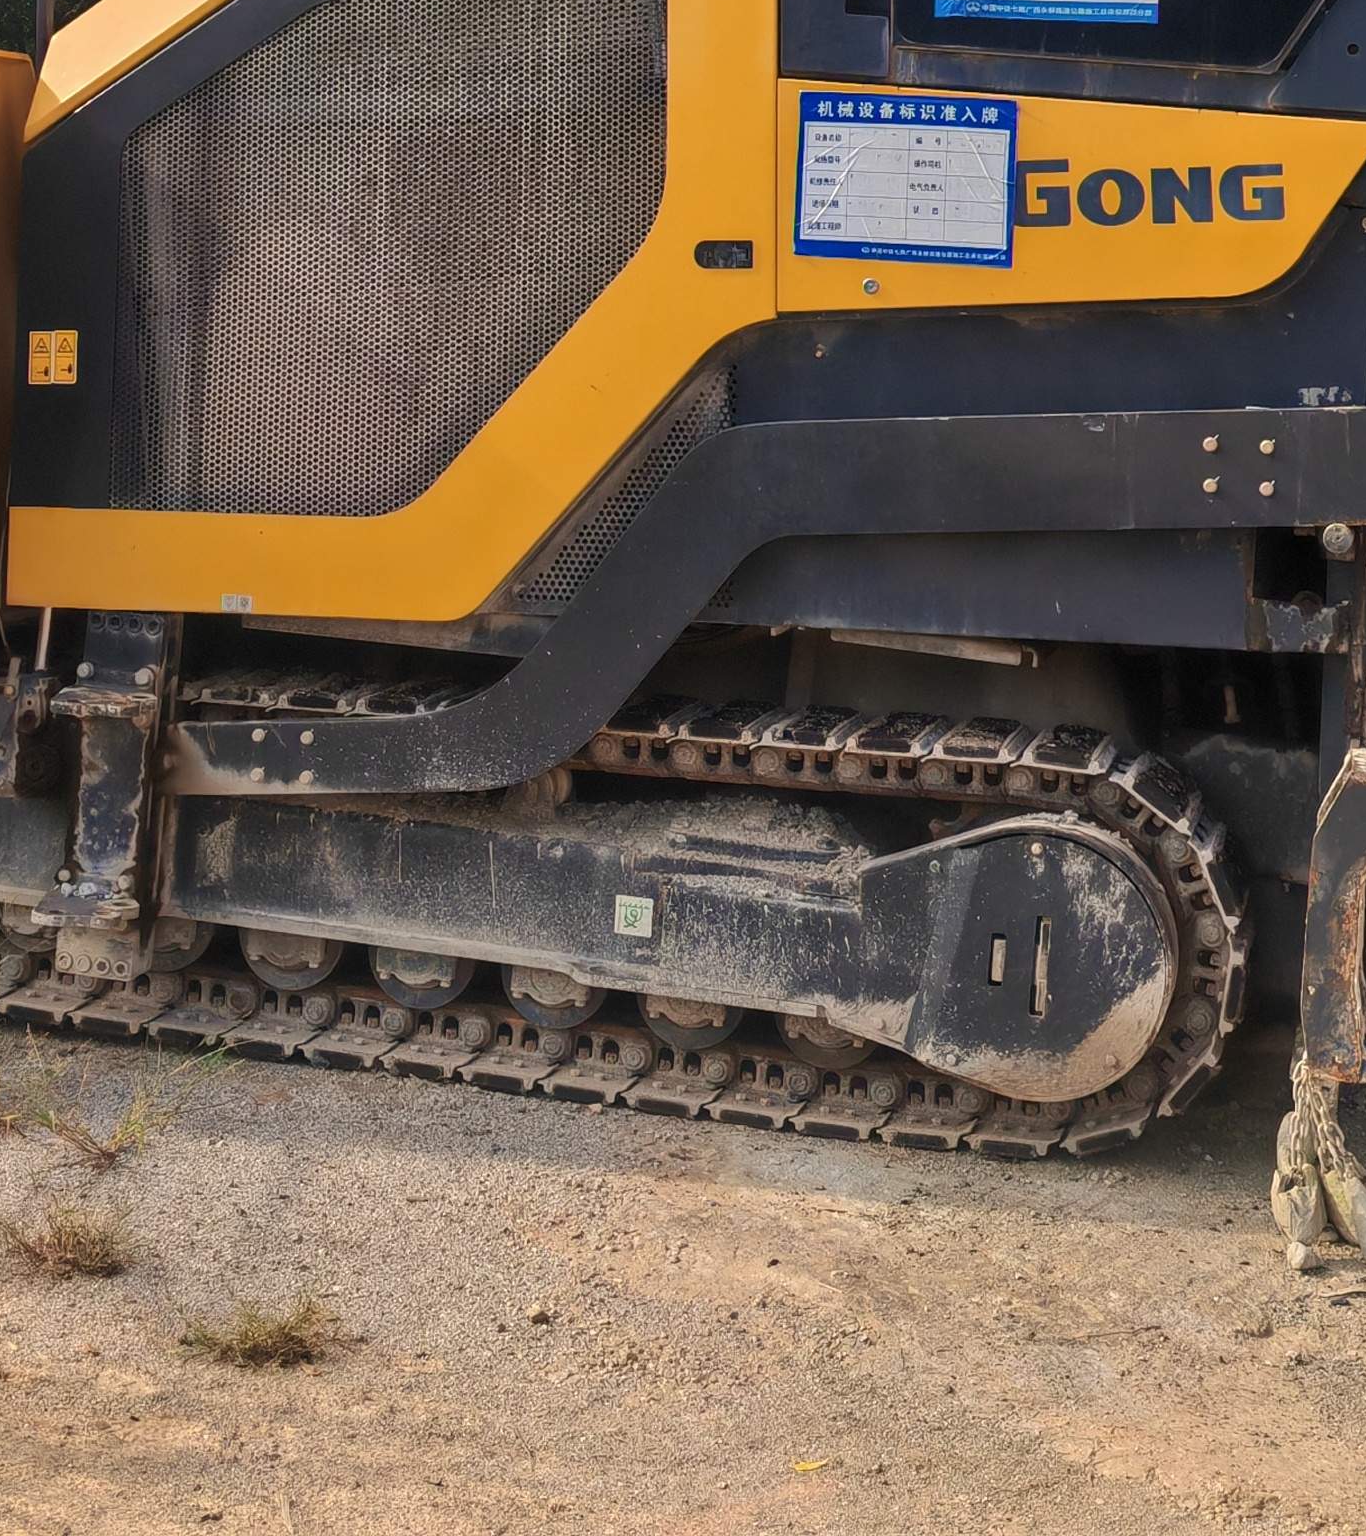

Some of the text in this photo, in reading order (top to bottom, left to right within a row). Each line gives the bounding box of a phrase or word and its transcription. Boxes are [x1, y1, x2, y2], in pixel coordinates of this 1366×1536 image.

[817, 100, 999, 124] 机械设备标识准入牌
[1014, 158, 1285, 228] GONG
